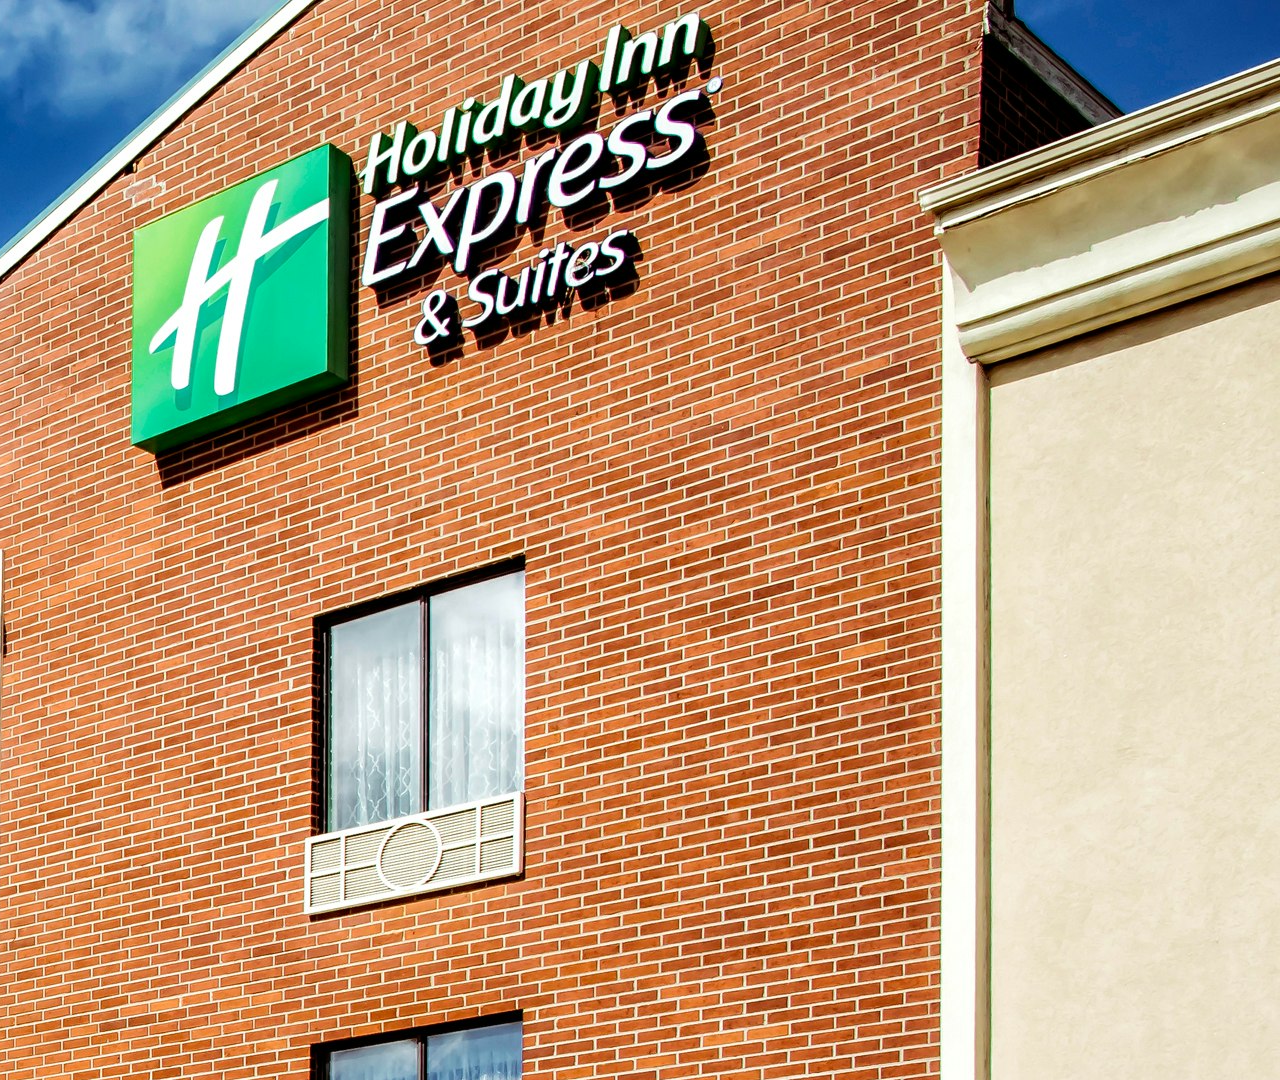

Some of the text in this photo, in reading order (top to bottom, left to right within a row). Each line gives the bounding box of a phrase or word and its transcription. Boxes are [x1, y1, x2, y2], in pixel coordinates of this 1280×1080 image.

[360, 11, 703, 193] Holiday Inn
[361, 88, 704, 287] Express
[413, 229, 630, 347] & Suites
